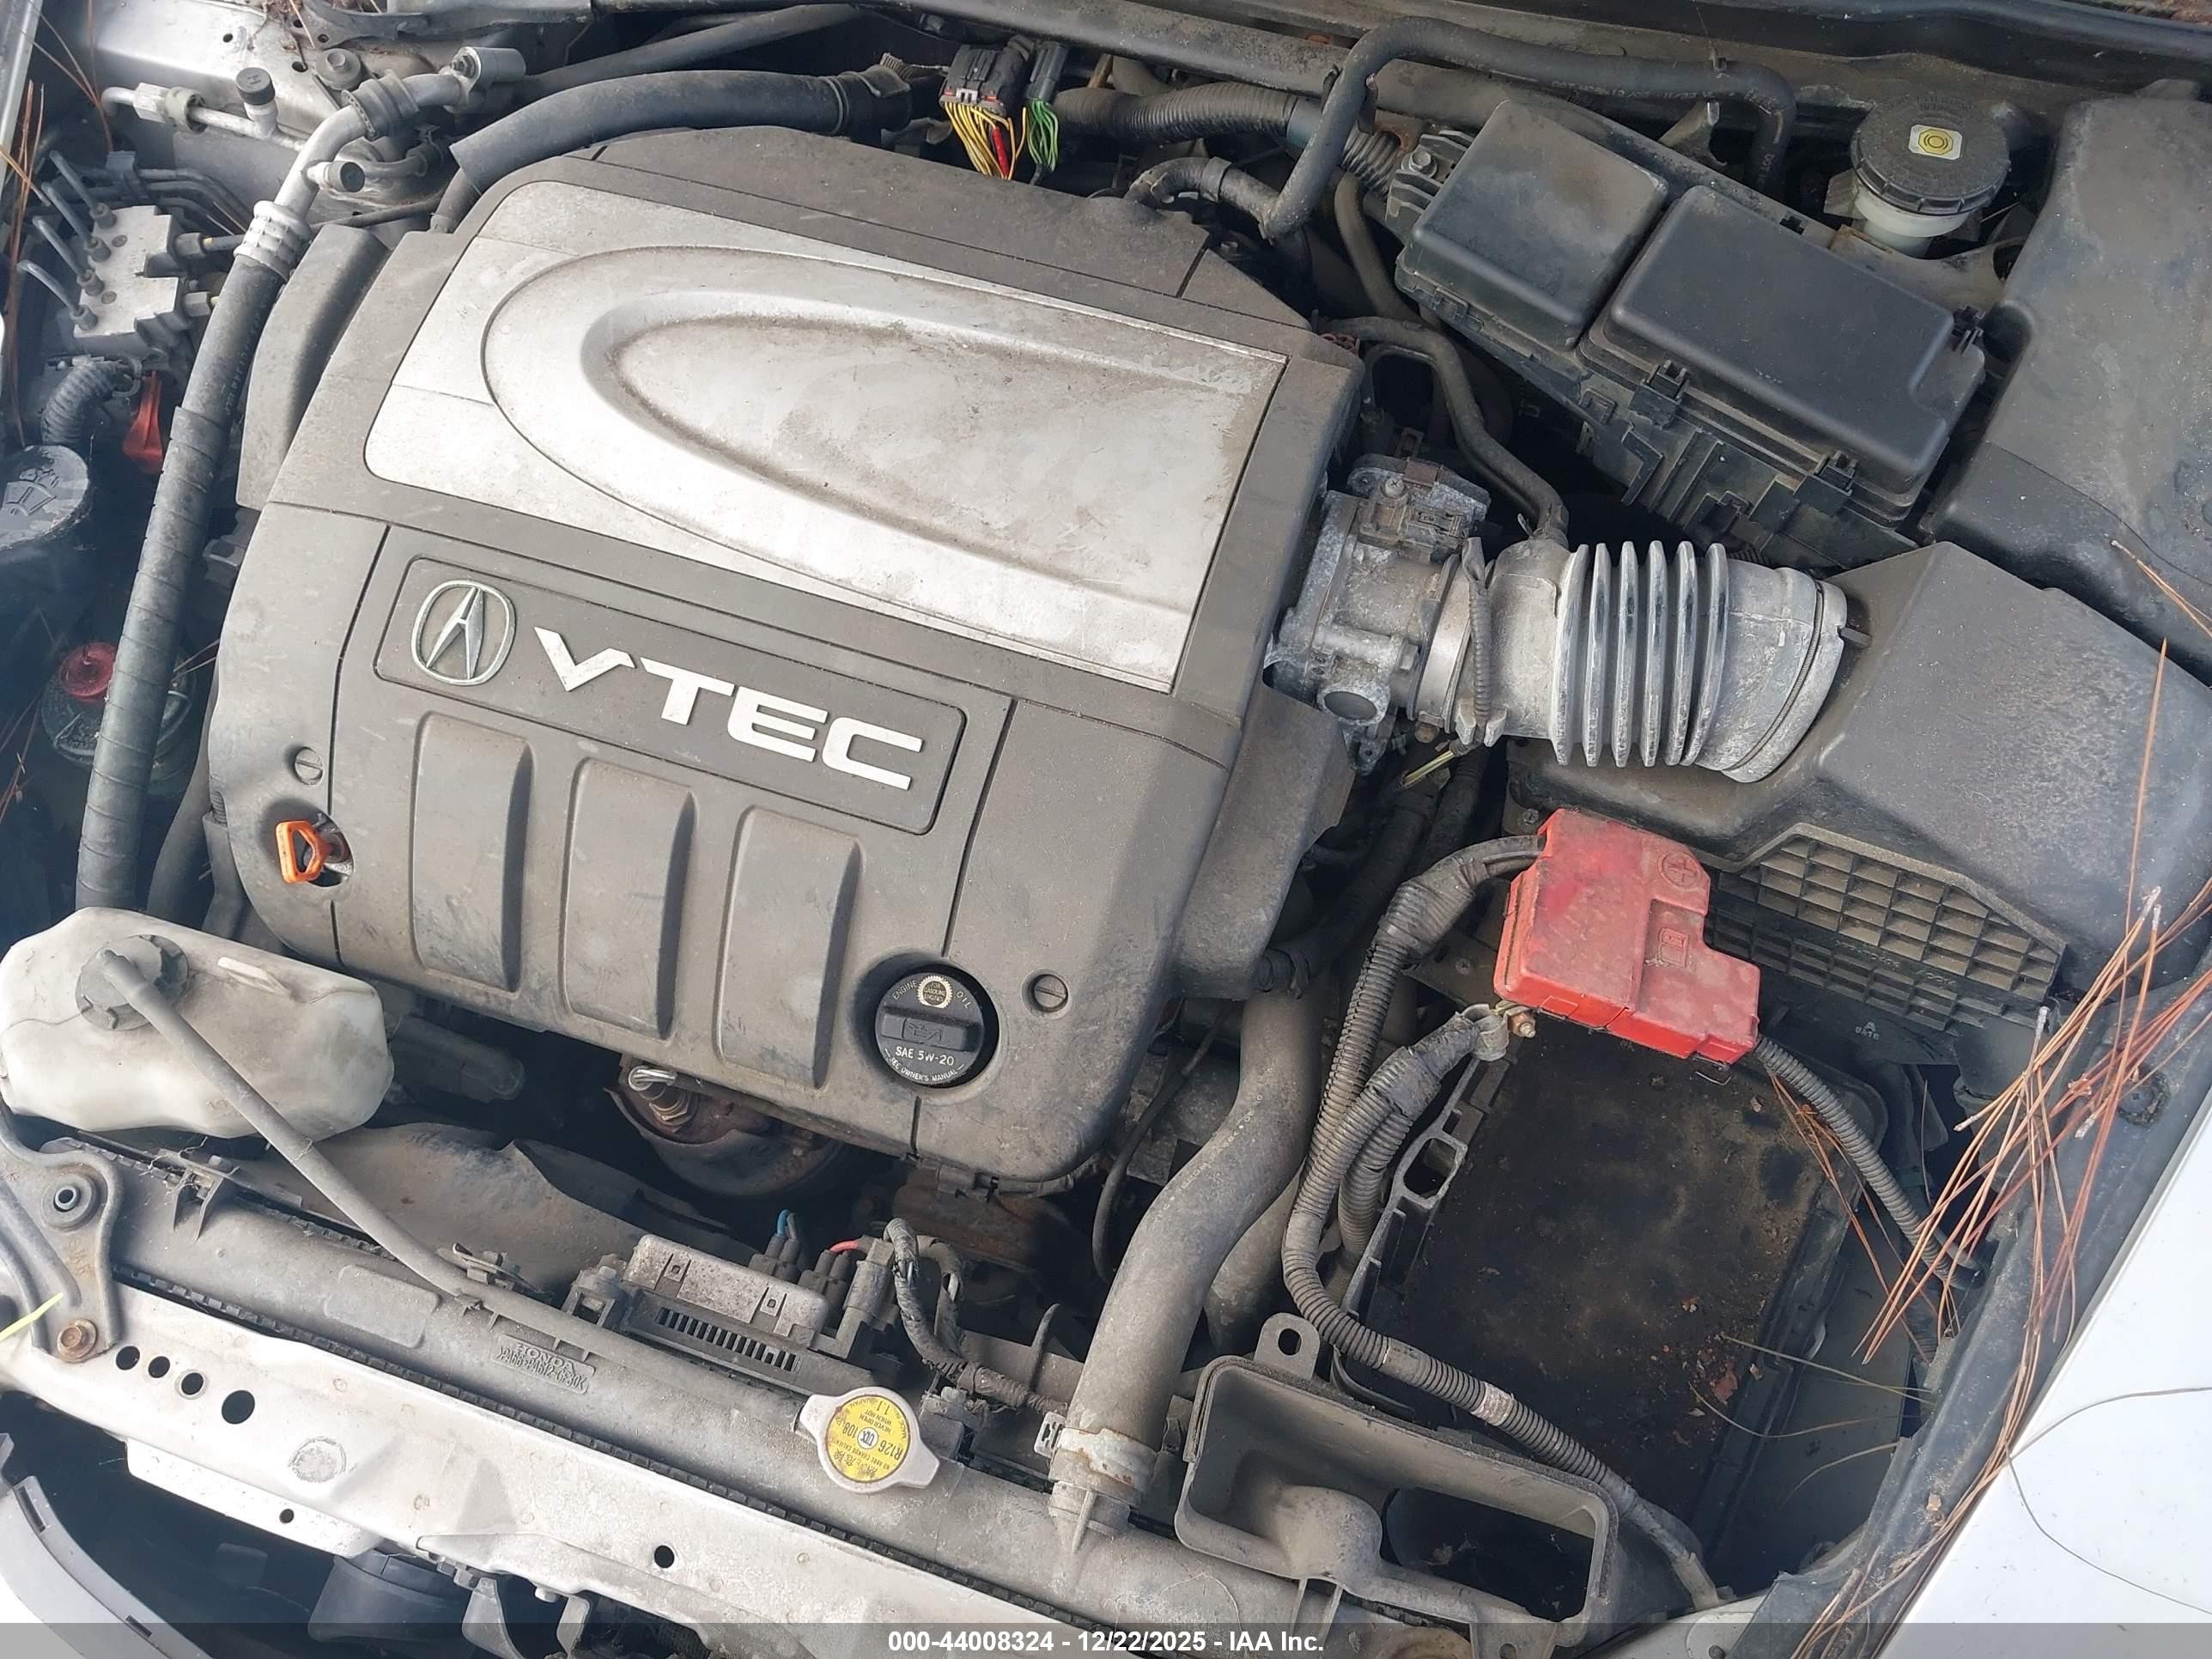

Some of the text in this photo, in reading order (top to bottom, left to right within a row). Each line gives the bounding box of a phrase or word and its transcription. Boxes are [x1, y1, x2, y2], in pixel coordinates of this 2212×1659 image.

[533, 626, 923, 791] VTEC
[892, 979, 972, 1009] ENGINE OIL
[895, 1046, 955, 1066] SAE 5W-20
[889, 1056, 958, 1082] SEE OWNER'S MANUAL
[517, 1342, 576, 1376] HONDA
[865, 1408, 892, 1425] WHEN HOT
[876, 1401, 890, 1415] 1.1
[859, 1413, 892, 1434] NEVER OPEN
[878, 1439, 903, 1461] R126
